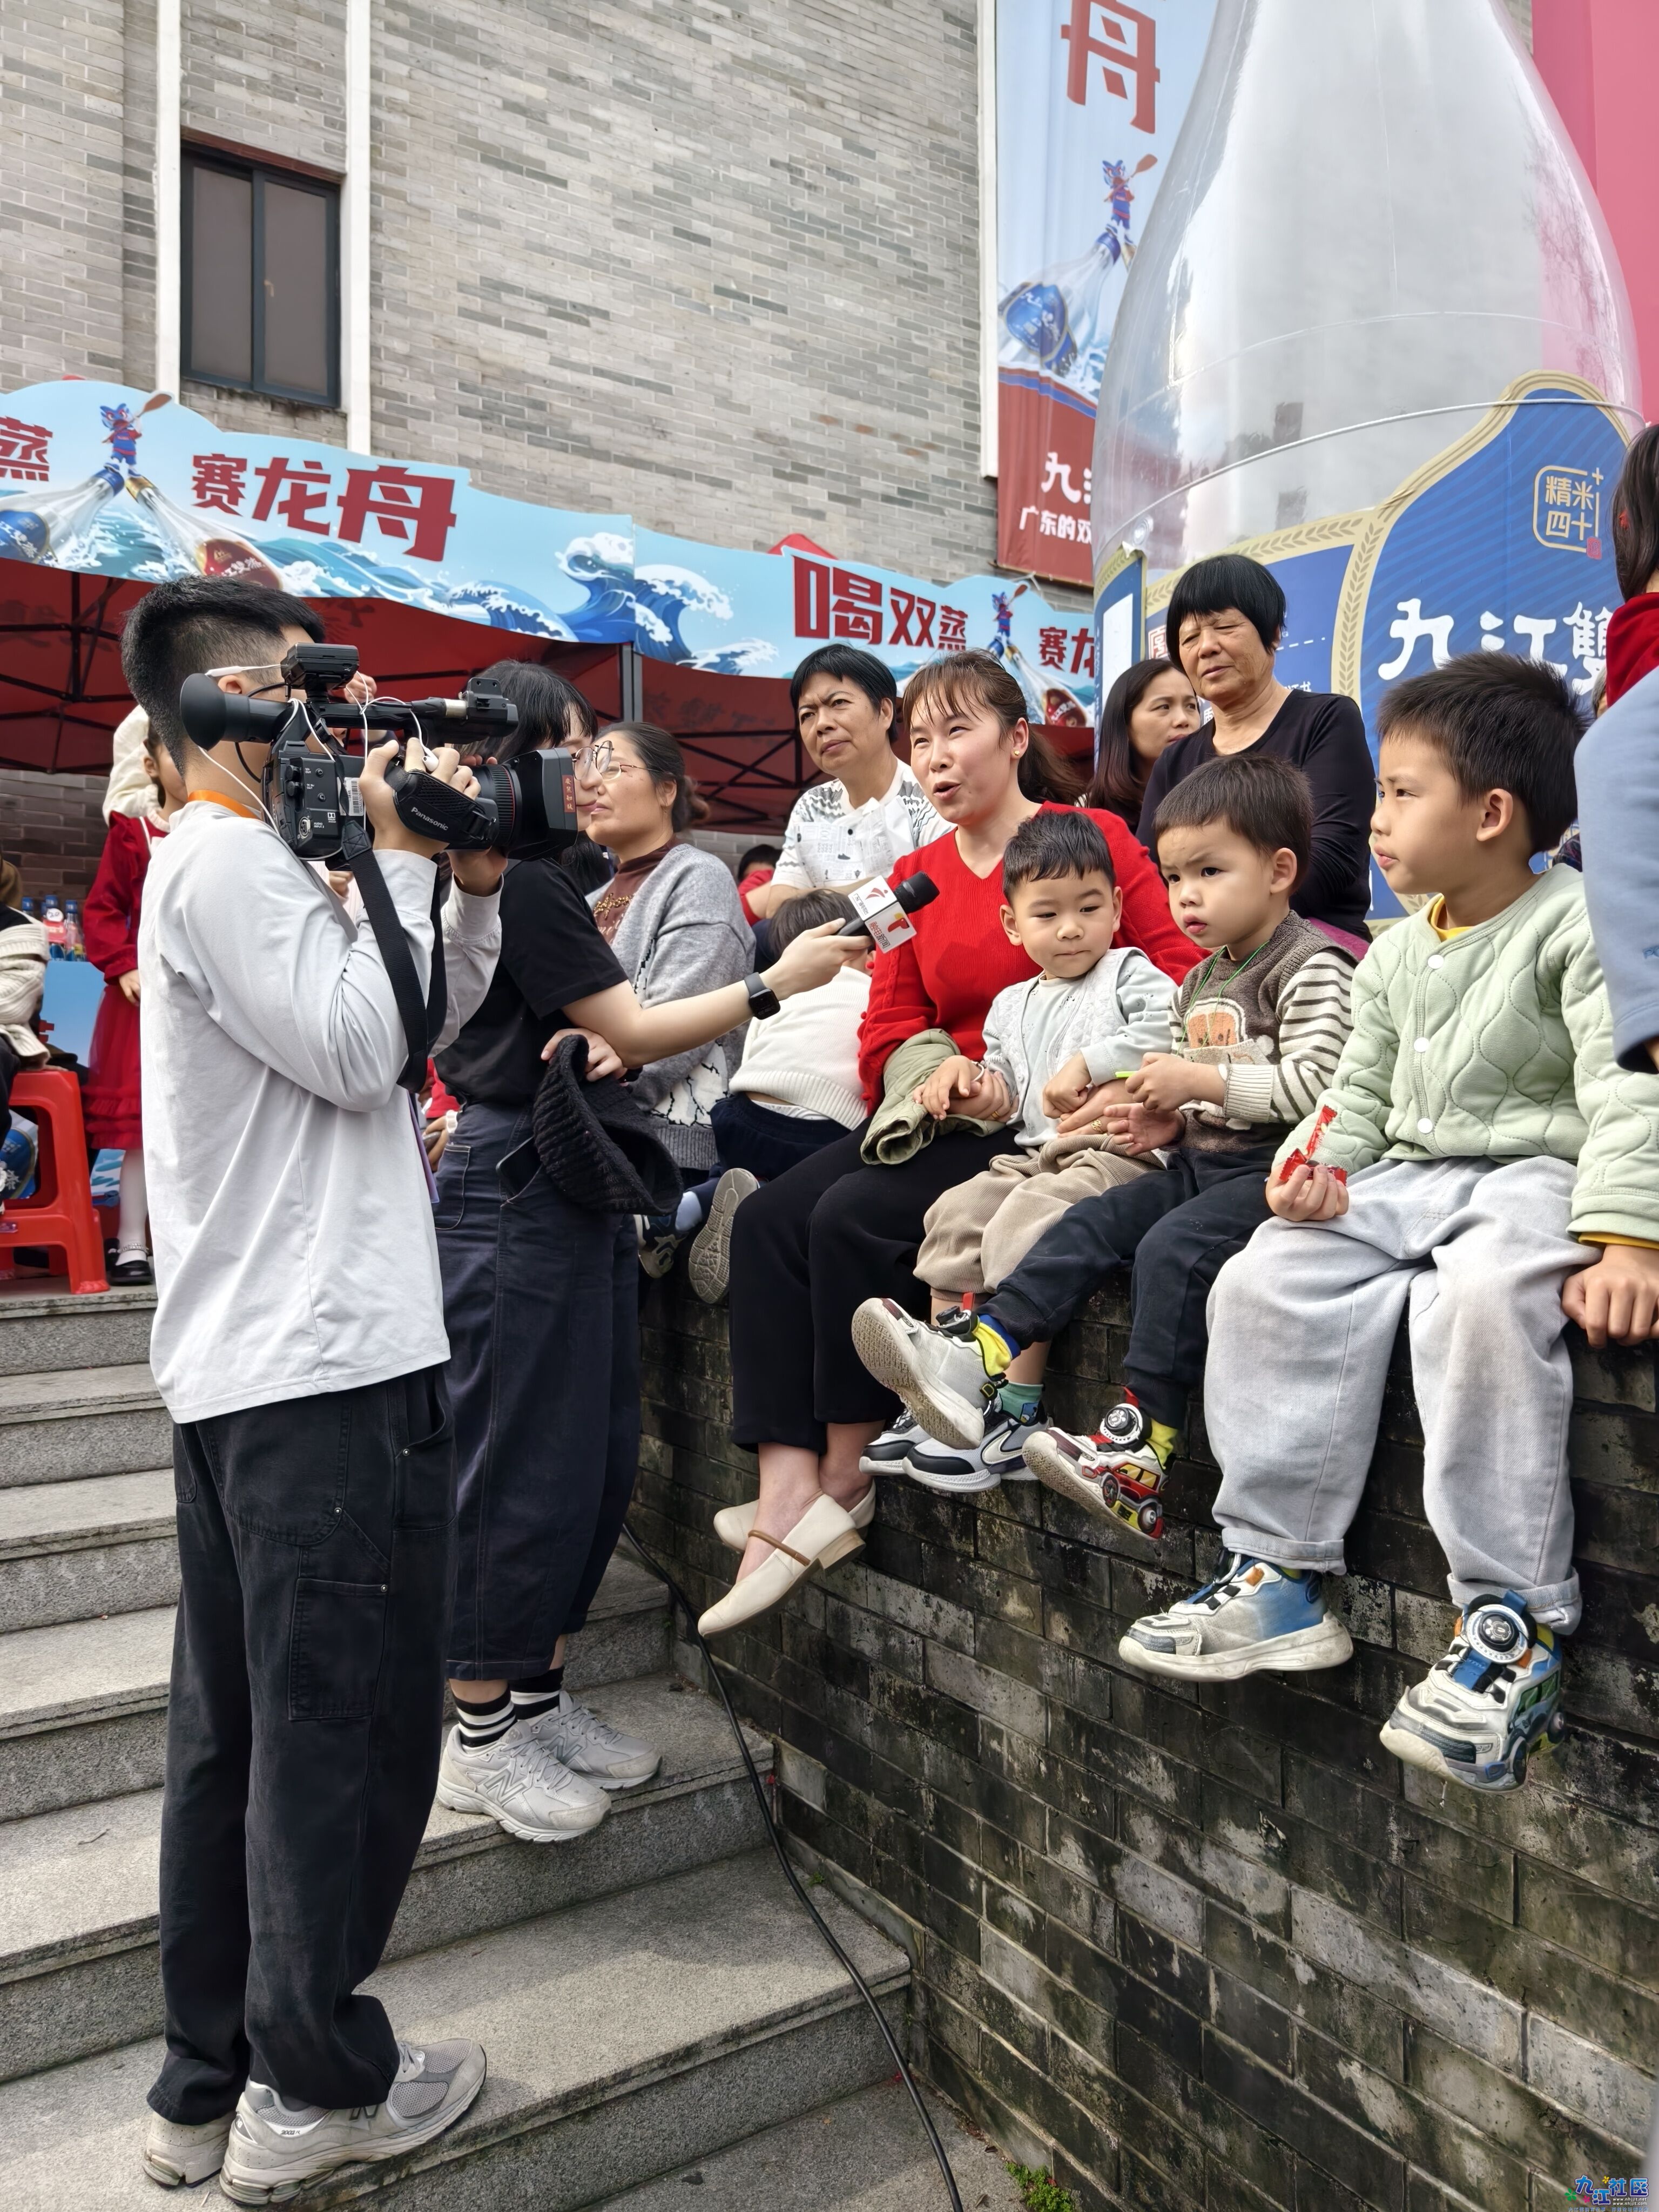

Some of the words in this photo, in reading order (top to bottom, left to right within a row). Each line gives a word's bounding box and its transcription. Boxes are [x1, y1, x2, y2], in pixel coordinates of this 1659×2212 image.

[1061, 0, 1161, 134] 舟
[191, 453, 457, 562] 赛龙舟
[1545, 476, 1594, 510] 精米
[1546, 510, 1593, 541] 四十
[792, 553, 969, 651] 喝双蒸
[411, 807, 449, 831] Panasonic
[868, 921, 891, 949] 触电新闻
